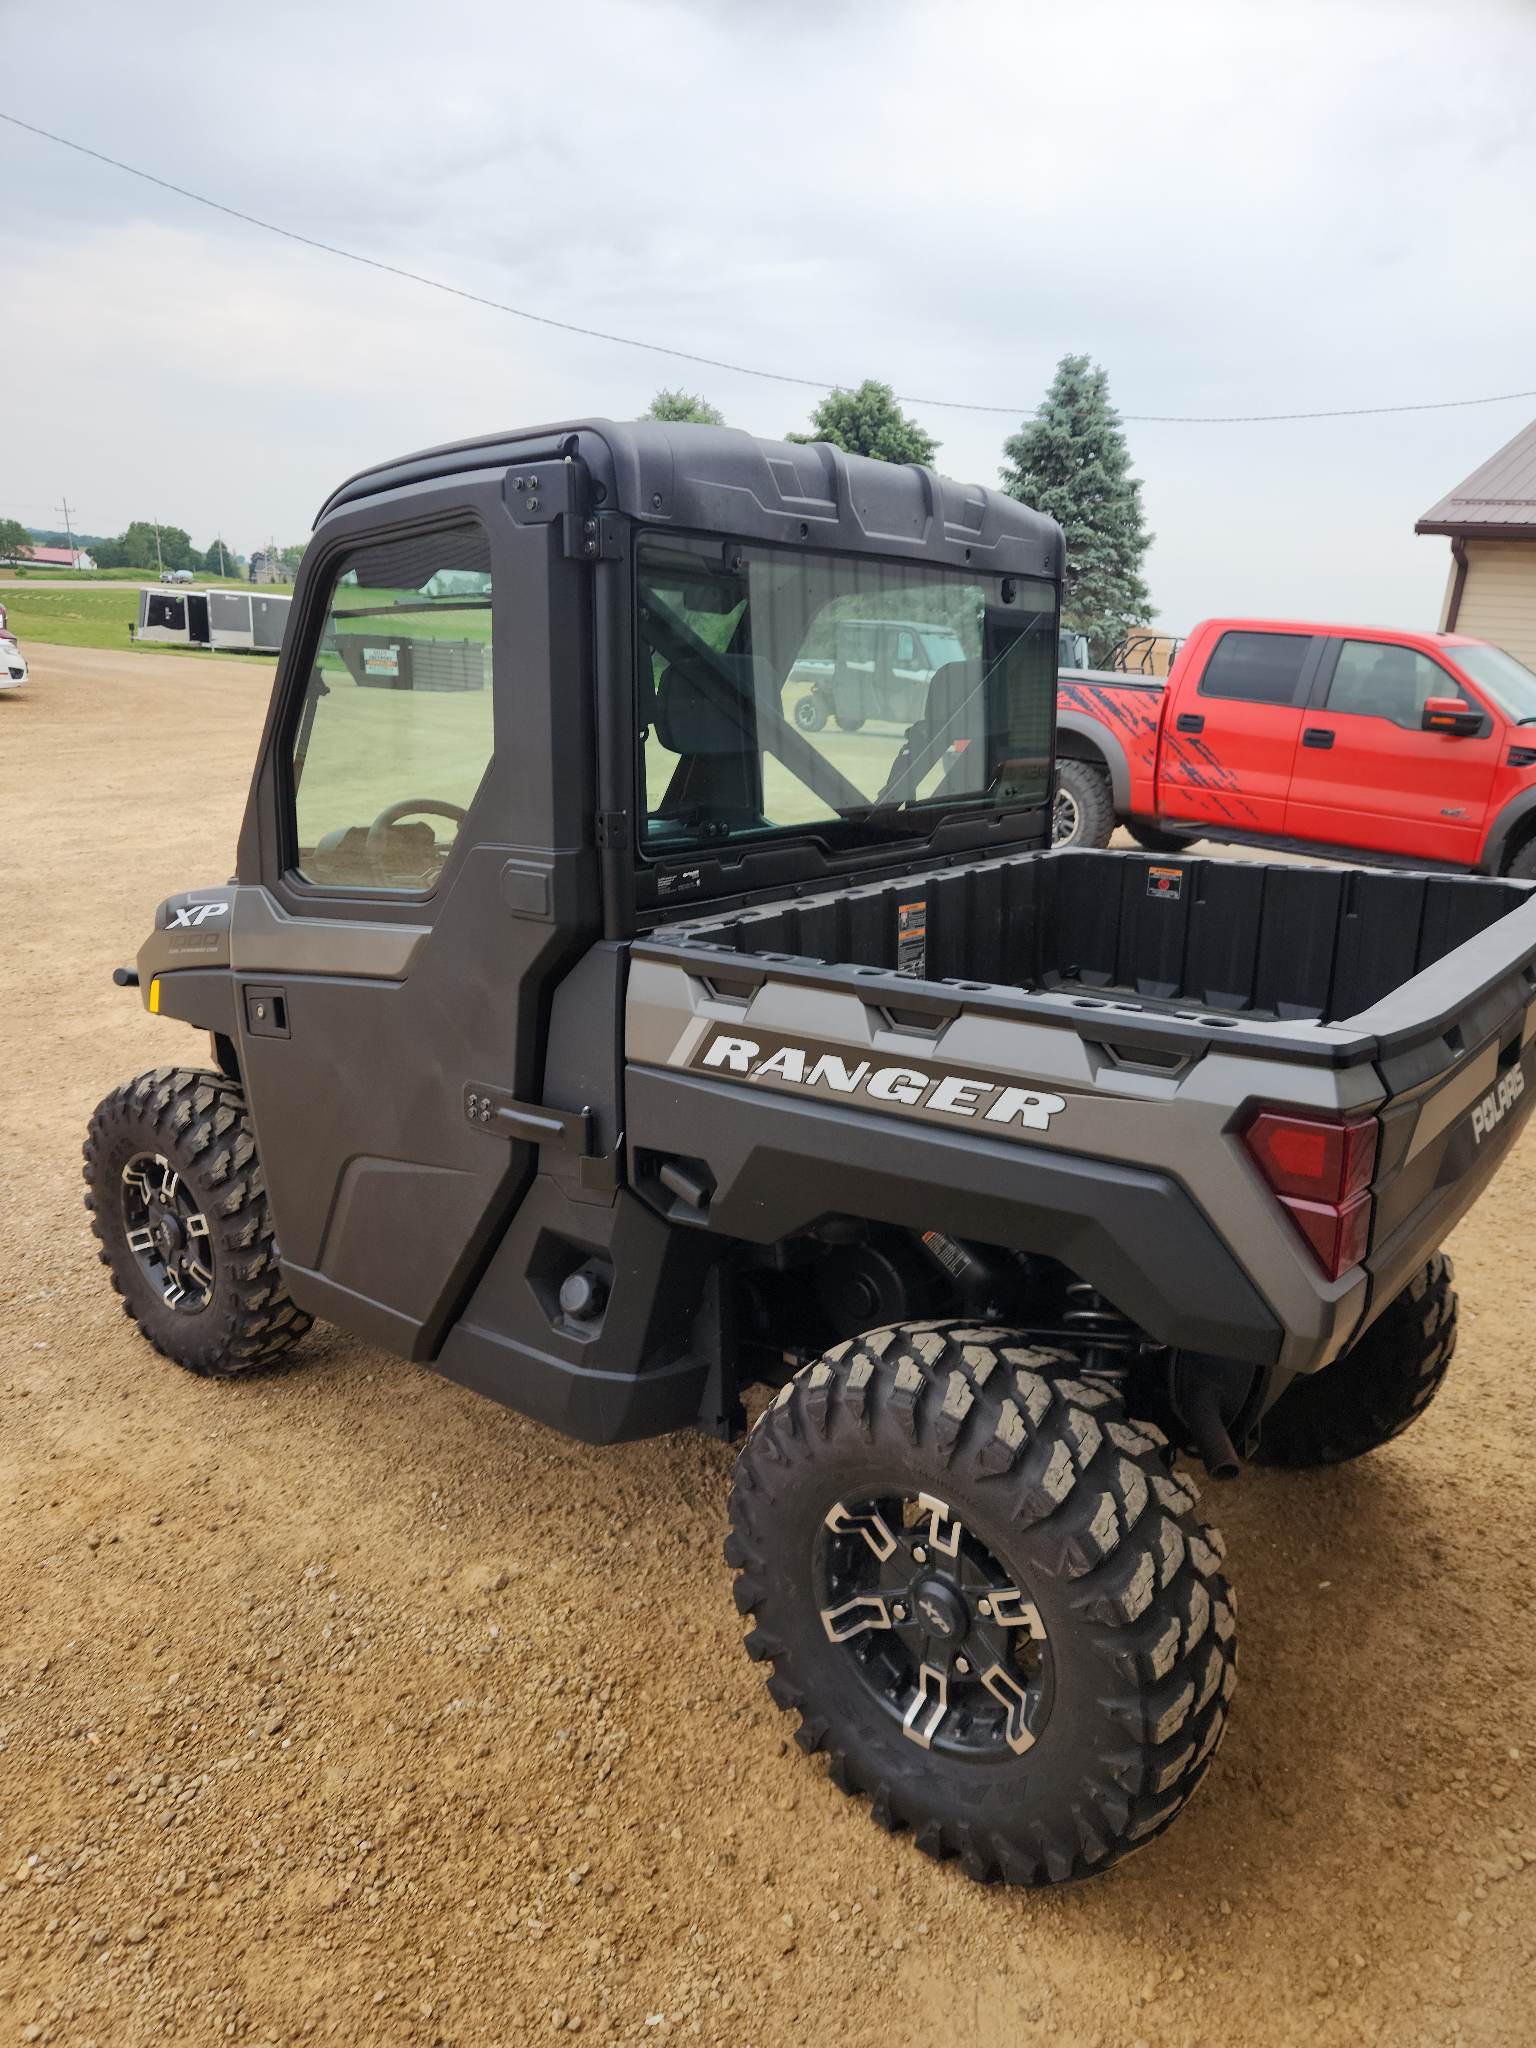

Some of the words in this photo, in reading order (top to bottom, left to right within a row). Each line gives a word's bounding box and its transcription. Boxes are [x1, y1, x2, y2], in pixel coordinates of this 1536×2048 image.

[164, 902, 229, 930] XP
[702, 1034, 1067, 1132] RANGER
[1471, 1061, 1525, 1145] POLARIS
